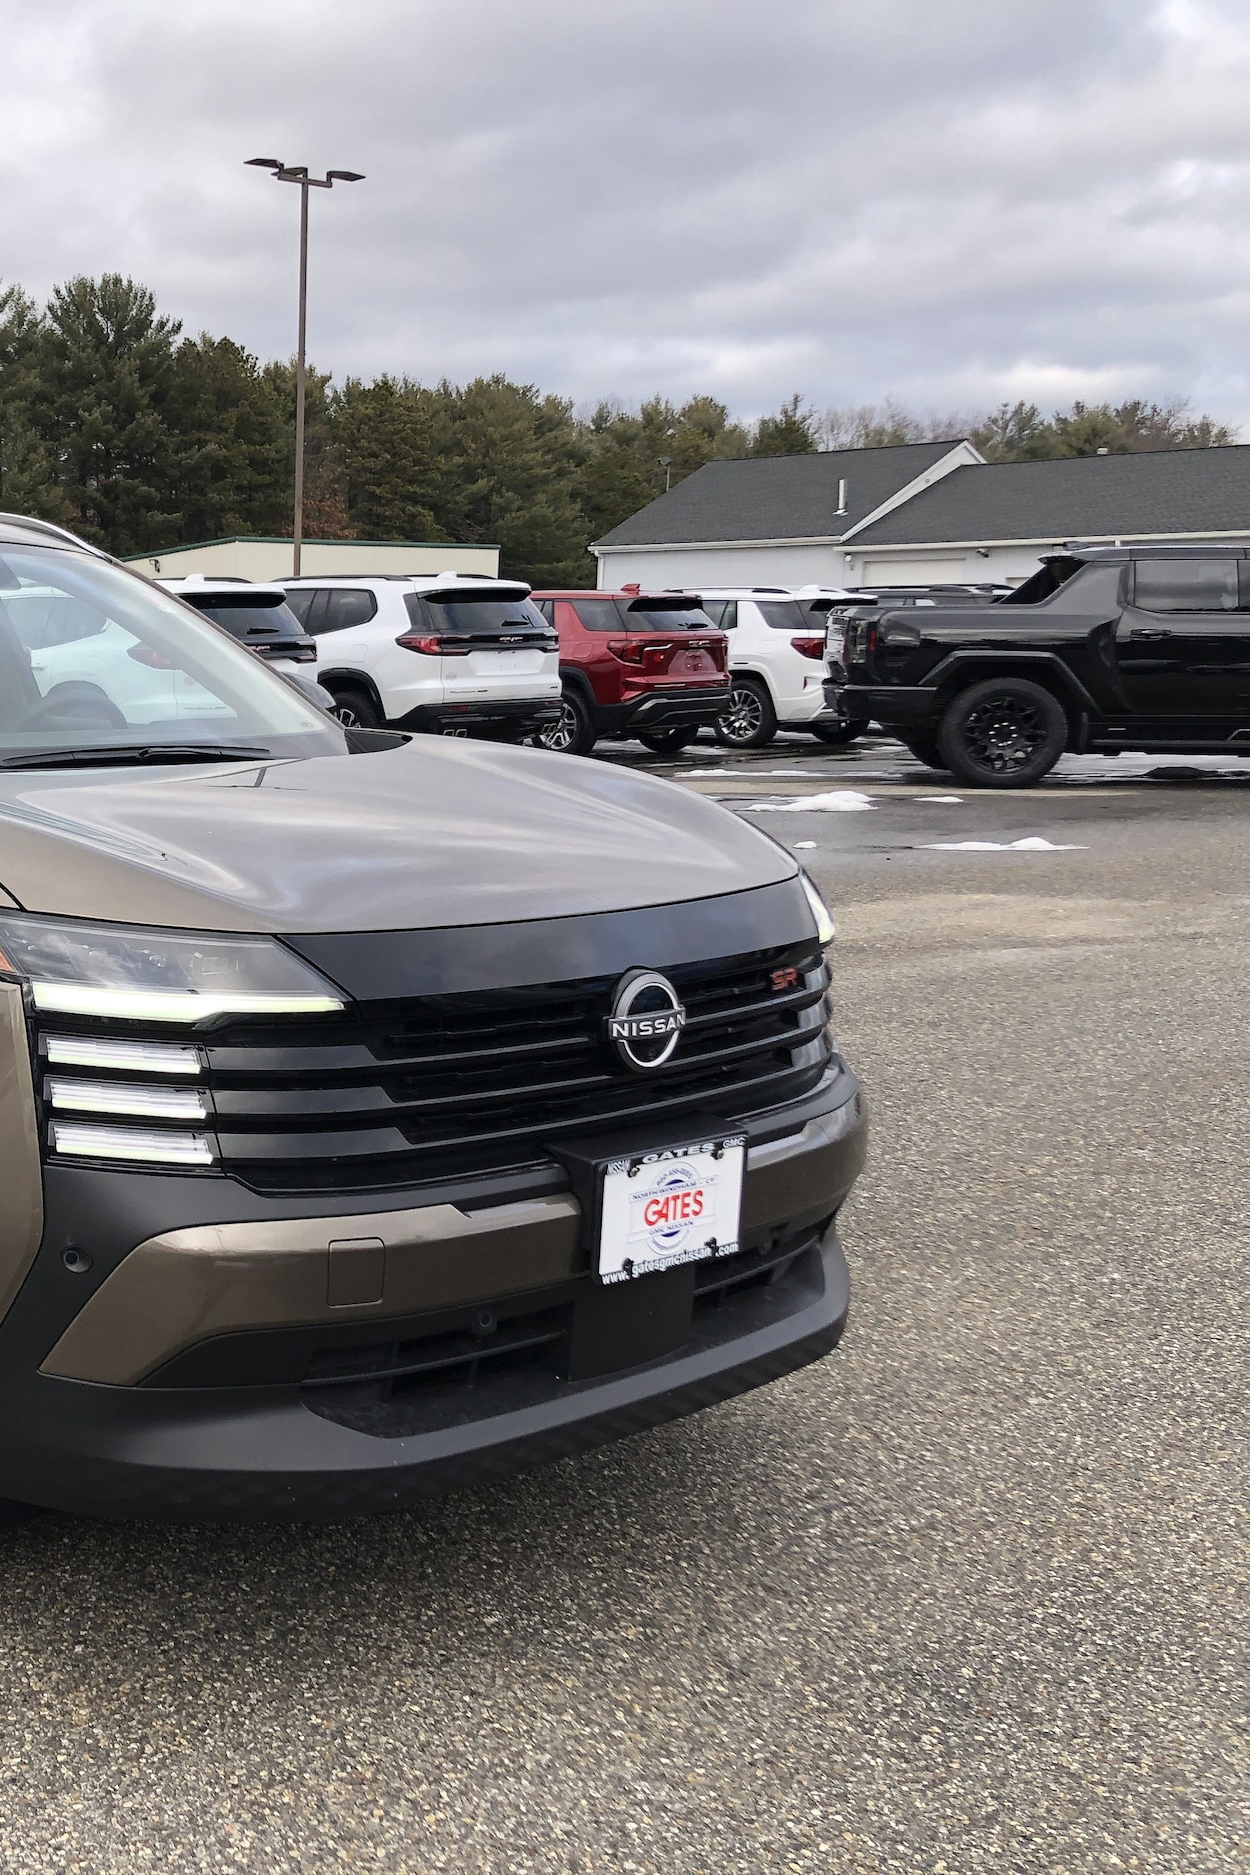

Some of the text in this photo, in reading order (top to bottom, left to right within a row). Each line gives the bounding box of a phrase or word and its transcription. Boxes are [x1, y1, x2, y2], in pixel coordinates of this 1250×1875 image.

[771, 968, 798, 991] SR
[612, 1012, 687, 1038] NISSAN
[642, 1142, 715, 1164] GATES
[722, 1137, 746, 1150] GMC
[644, 1190, 703, 1226] GATES
